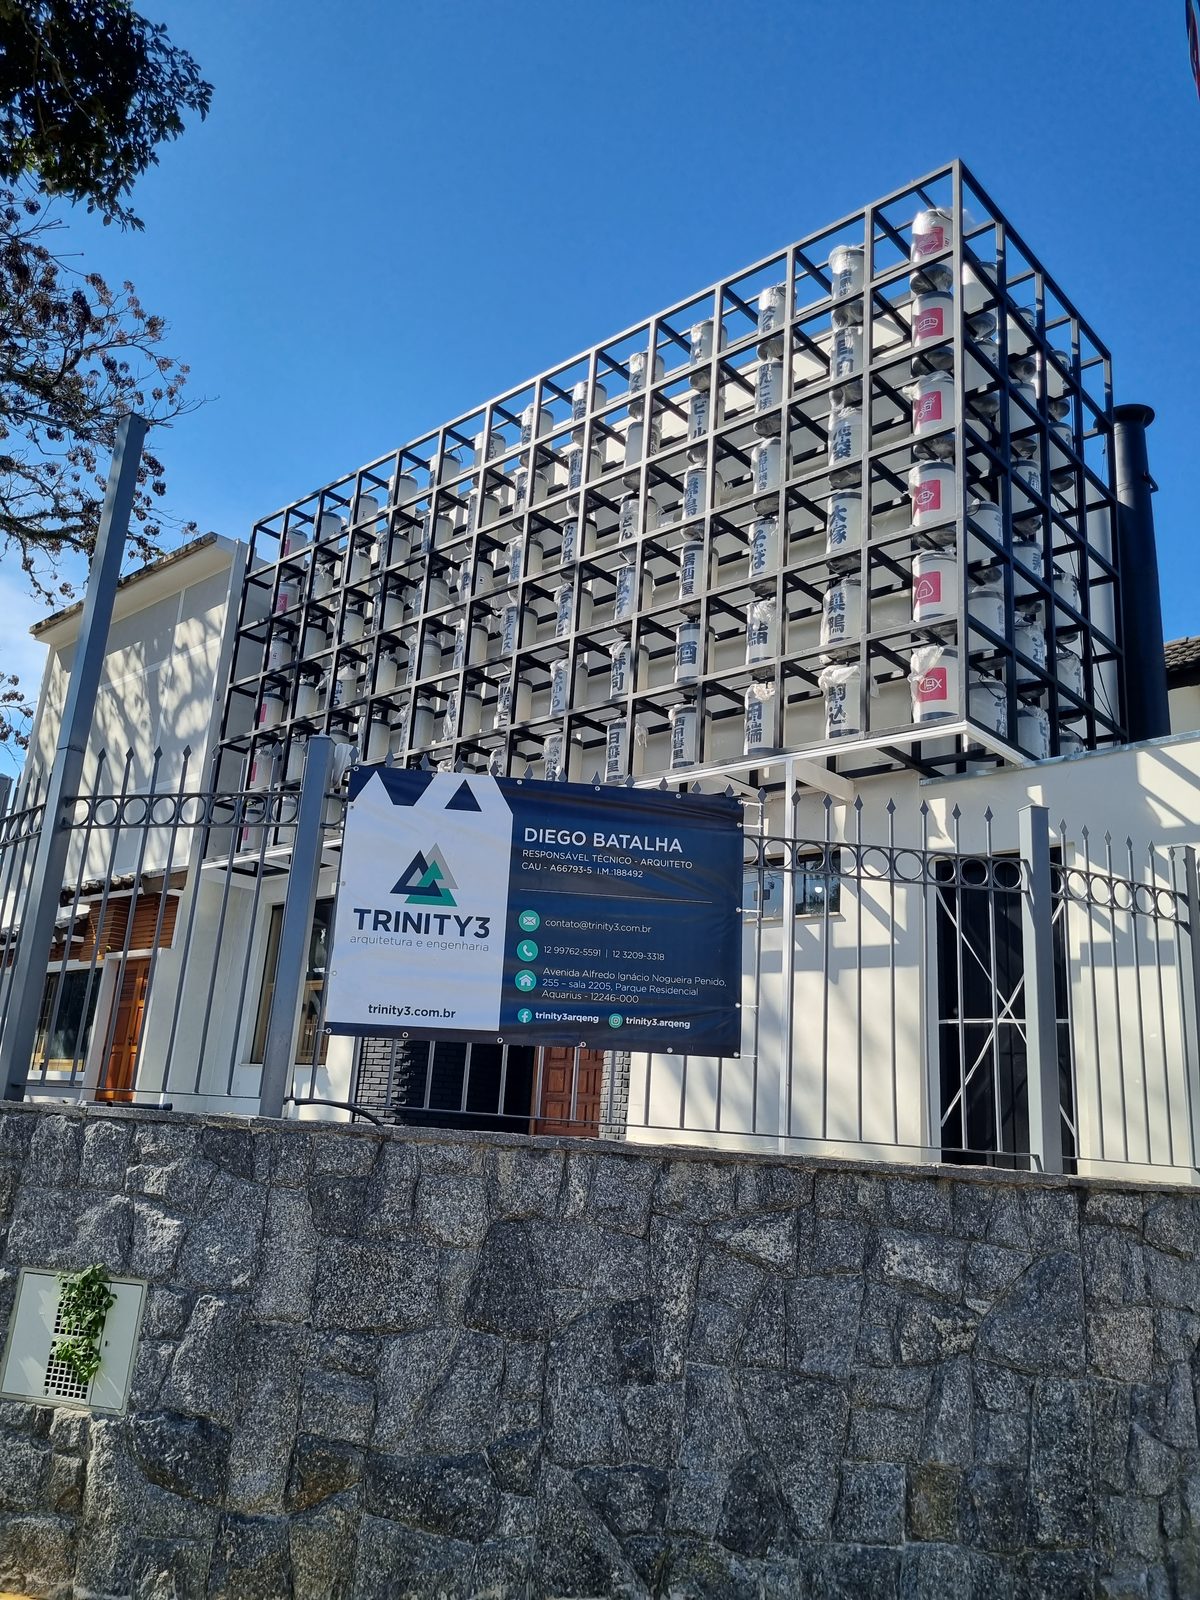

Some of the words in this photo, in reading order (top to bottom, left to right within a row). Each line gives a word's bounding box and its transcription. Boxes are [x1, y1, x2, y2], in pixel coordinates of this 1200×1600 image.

[830, 504, 848, 546] 大塚
[828, 592, 846, 636] 巣鴨
[828, 683, 847, 727] 駒込
[607, 732, 621, 775] 日暮里
[524, 827, 587, 846] DIEGO
[593, 832, 683, 853] BATALHA
[521, 862, 542, 871] CAU
[522, 849, 590, 862] RESPONSÁVEL
[592, 853, 632, 866] TÉCNICO
[640, 858, 693, 869] ARQUITETO
[353, 908, 491, 939] TRINITY3
[545, 918, 652, 933] contato@trinity3.com.br
[350, 934, 413, 947] arquitetura
[416, 939, 423, 948] e
[426, 939, 489, 952] engenharia
[544, 946, 552, 954] 12
[553, 946, 601, 957] 99762-5591
[612, 950, 620, 959] 12
[623, 951, 665, 961] 3209-3318
[543, 967, 580, 978] Avenida
[582, 969, 616, 980] Alfredo
[618, 972, 650, 982] Ignácio
[652, 974, 692, 985] Nogueira
[694, 976, 727, 987] Penido,
[542, 978, 560, 987] 255
[569, 981, 586, 989] sala
[615, 983, 647, 993] Parque
[649, 985, 699, 996] Residencial
[541, 990, 582, 1000] Aquarius
[590, 992, 640, 1004] 12246-000
[368, 1004, 456, 1018] trinity3.com.br
[535, 1011, 600, 1024] trinity3arqeng
[626, 1016, 691, 1030] trinity3.arqeng
